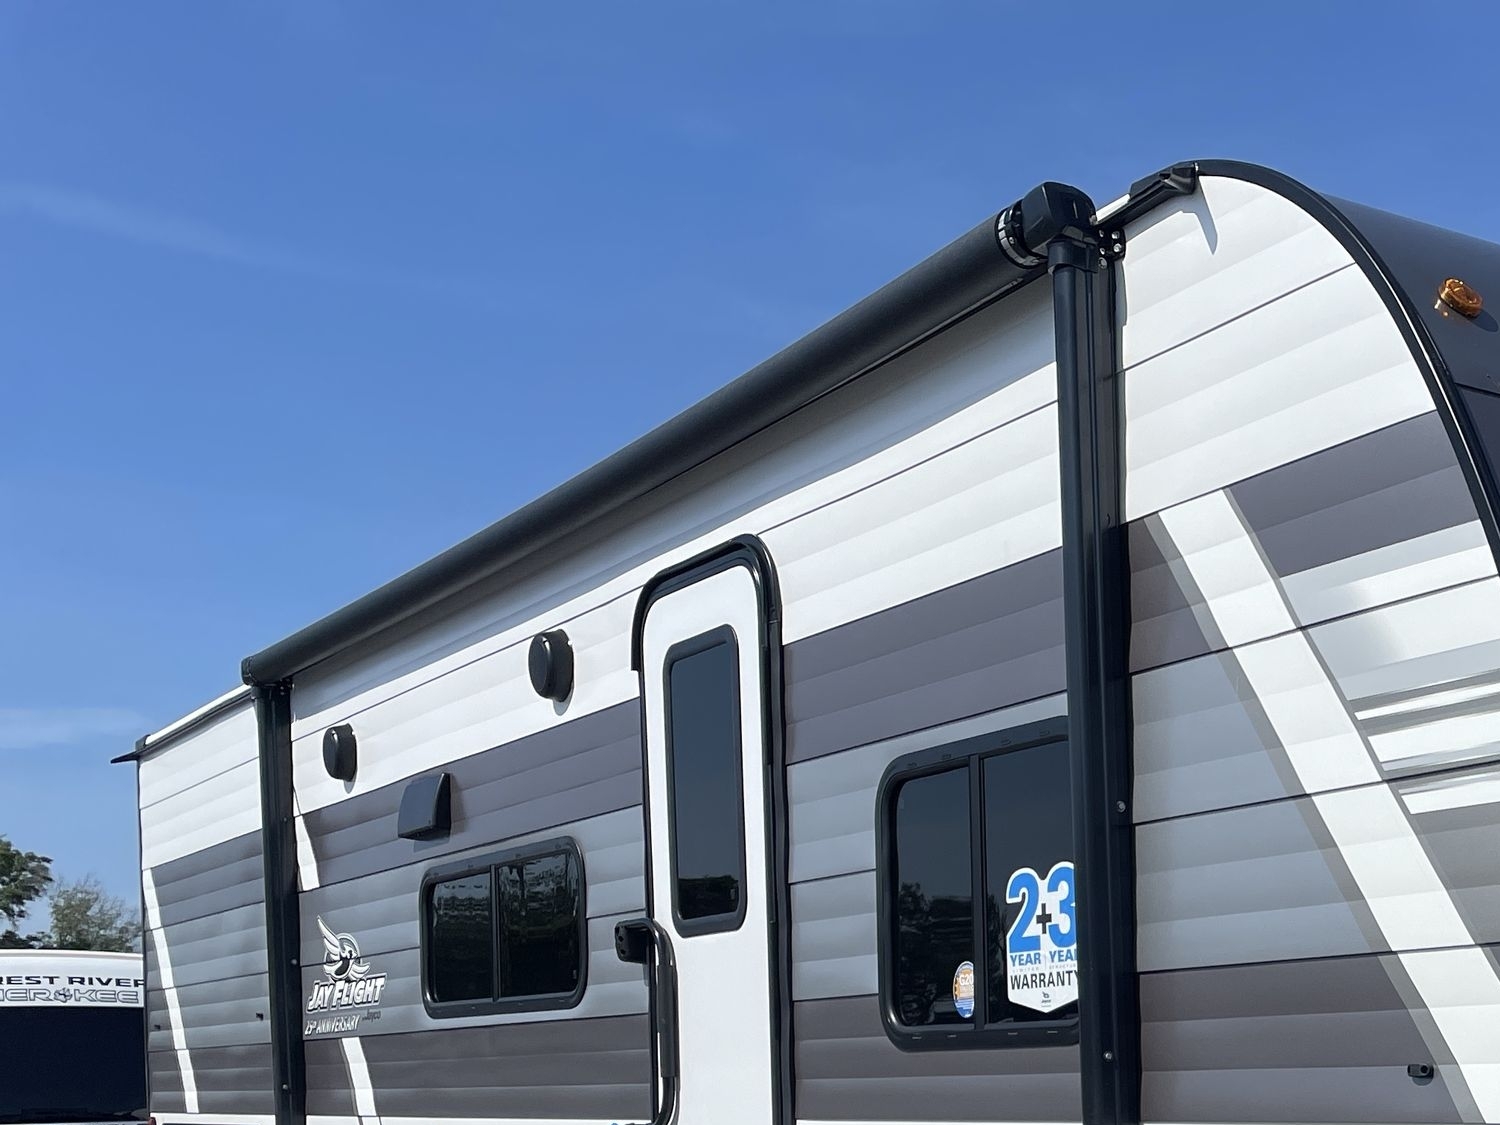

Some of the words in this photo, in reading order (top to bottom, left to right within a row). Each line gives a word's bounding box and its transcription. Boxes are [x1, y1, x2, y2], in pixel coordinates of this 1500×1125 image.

[1010, 952, 1041, 967] YEAR
[306, 980, 335, 1013] JAY
[331, 973, 386, 1010] FLIGHT
